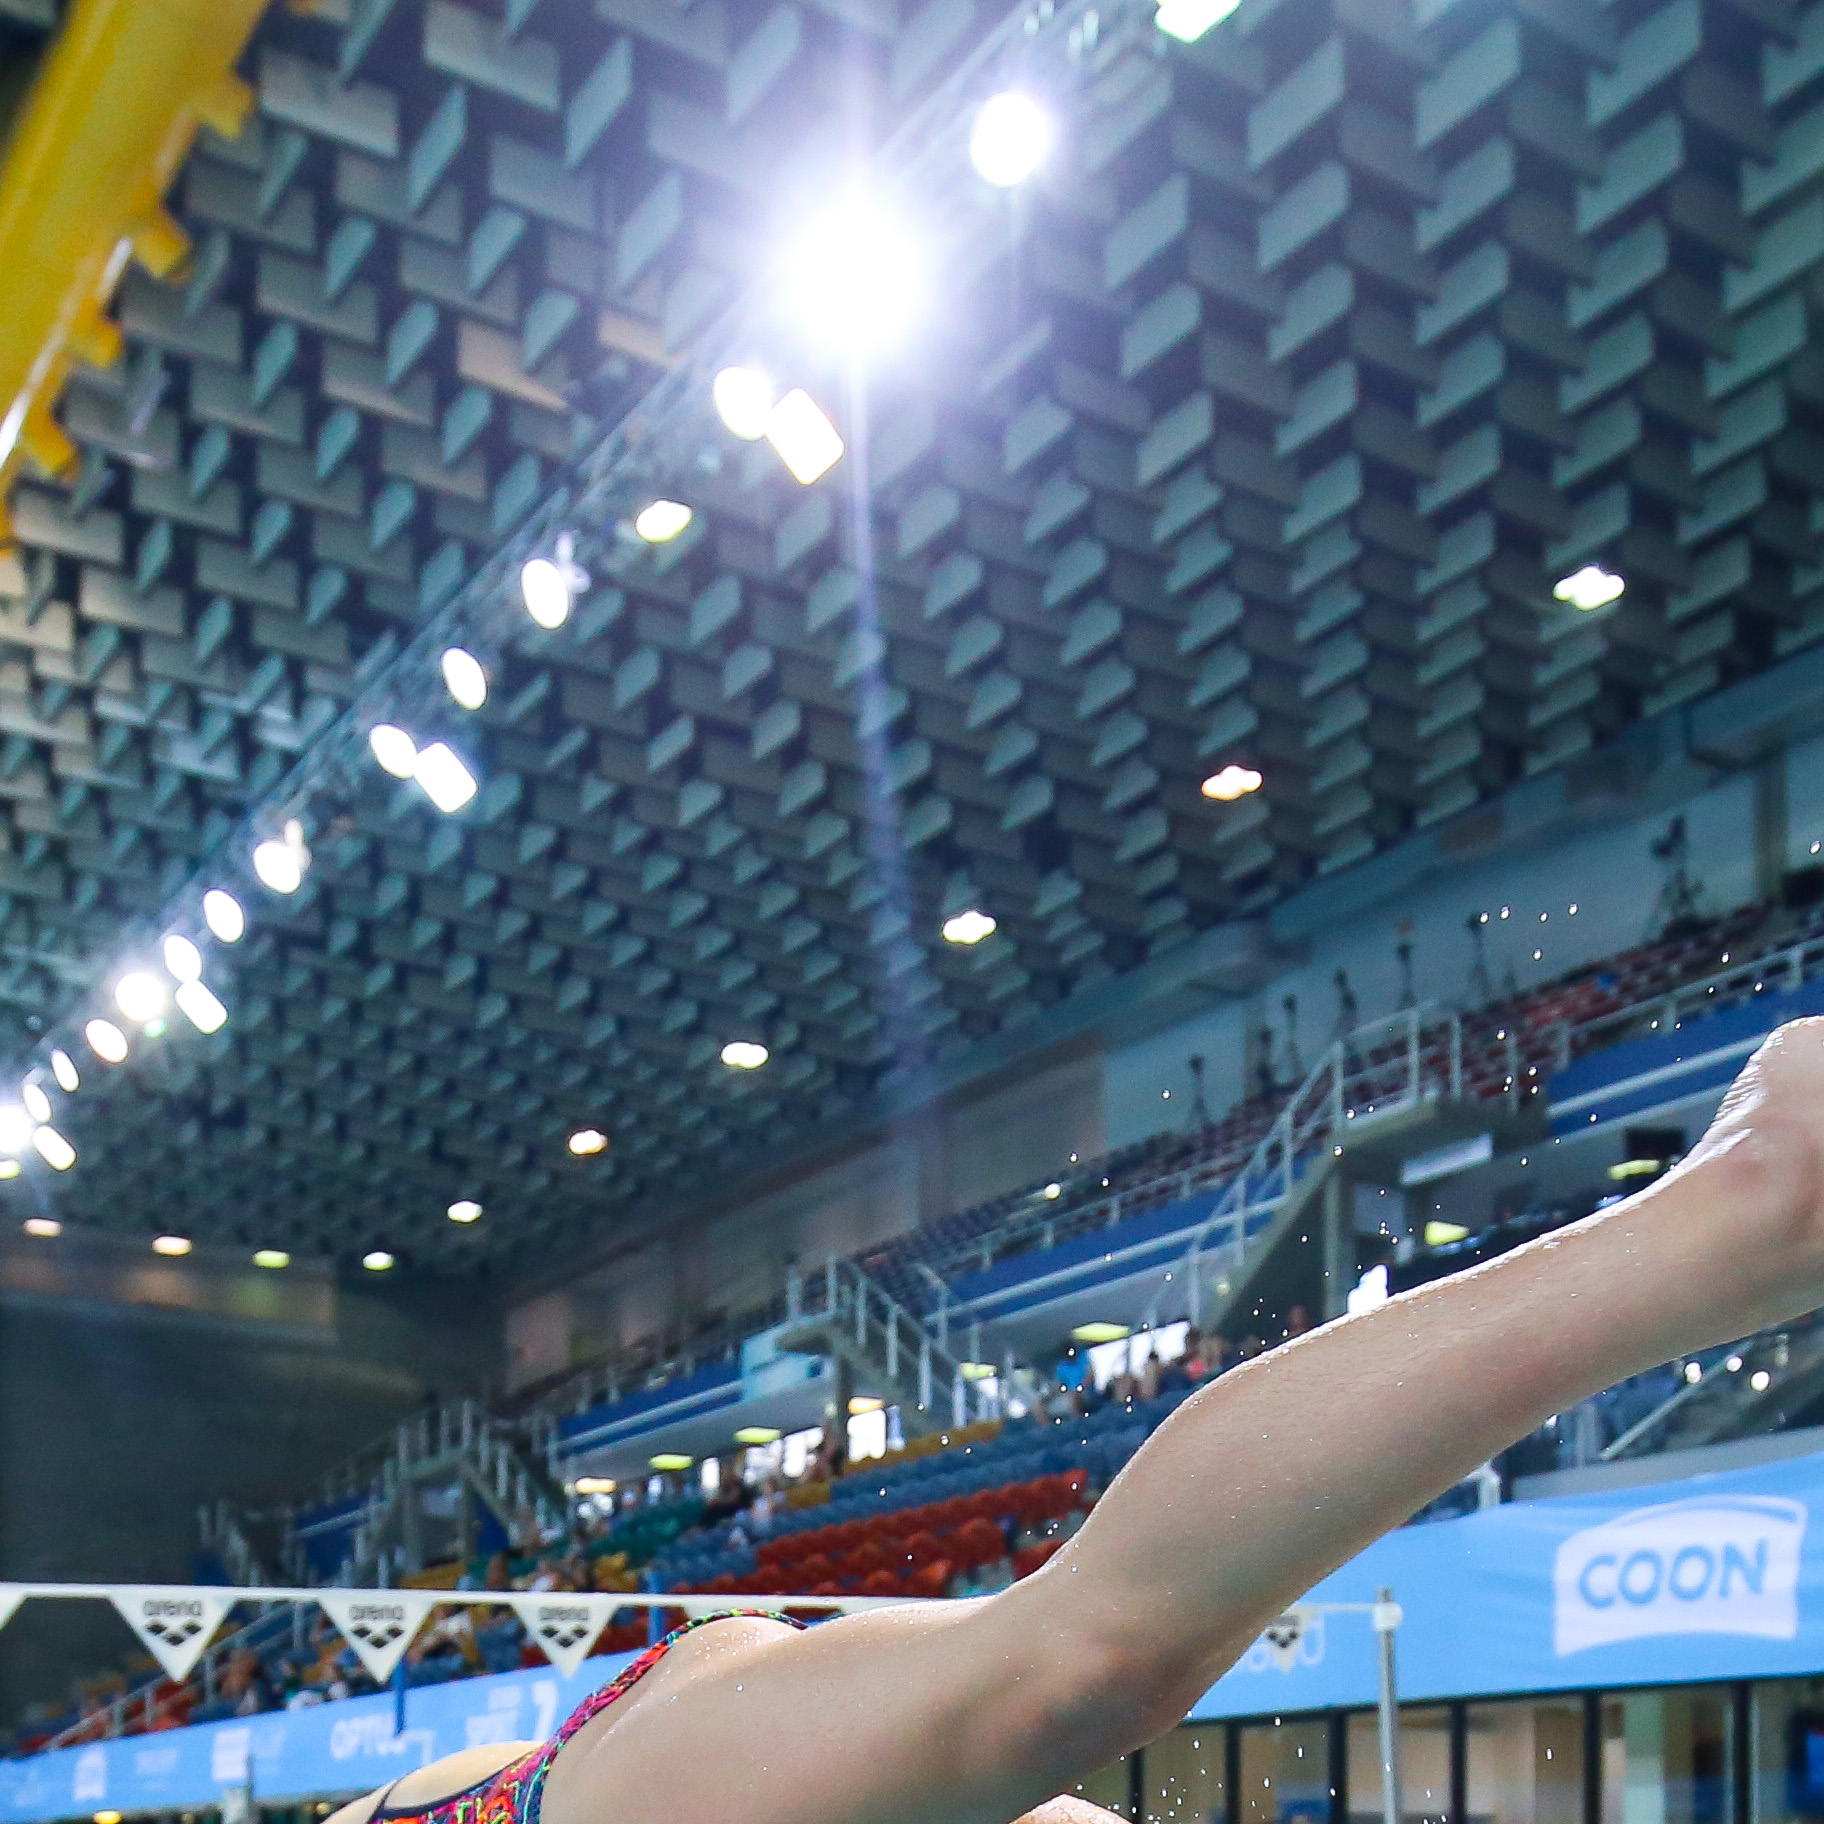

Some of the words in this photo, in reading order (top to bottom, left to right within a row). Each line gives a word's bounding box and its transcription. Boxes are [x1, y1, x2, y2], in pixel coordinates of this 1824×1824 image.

[1579, 1539, 1768, 1609] COON
[143, 1599, 202, 1617] arena
[350, 1603, 404, 1621] arena
